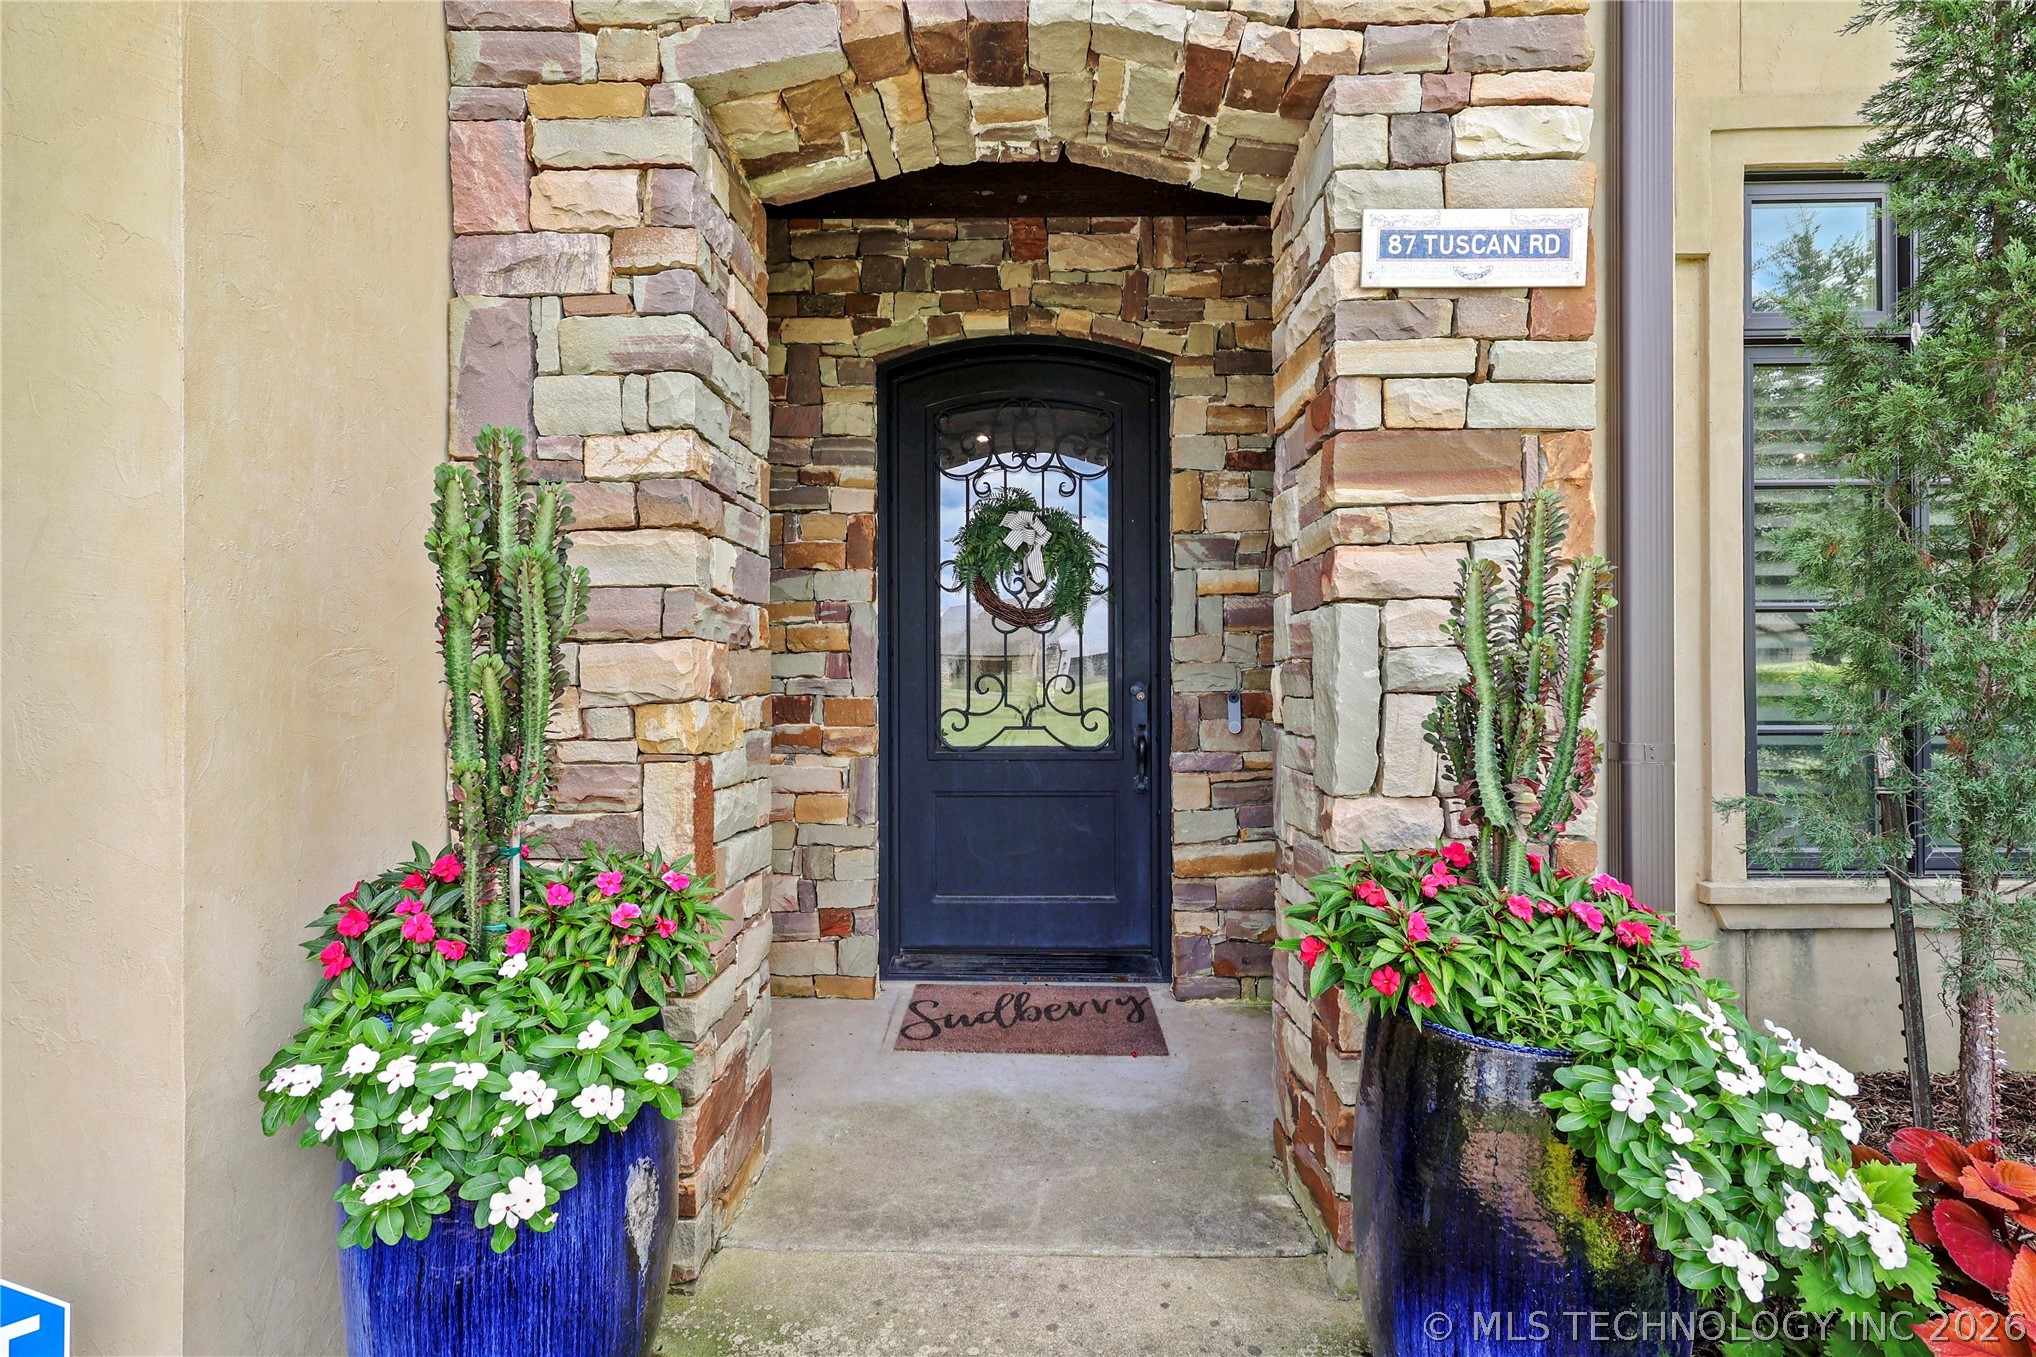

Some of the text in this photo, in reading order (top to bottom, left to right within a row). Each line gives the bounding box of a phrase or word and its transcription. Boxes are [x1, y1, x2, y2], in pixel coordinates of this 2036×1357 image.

[1388, 234, 1561, 255] 87 TUSCAN RD
[900, 992, 1150, 1040] Sudberry
